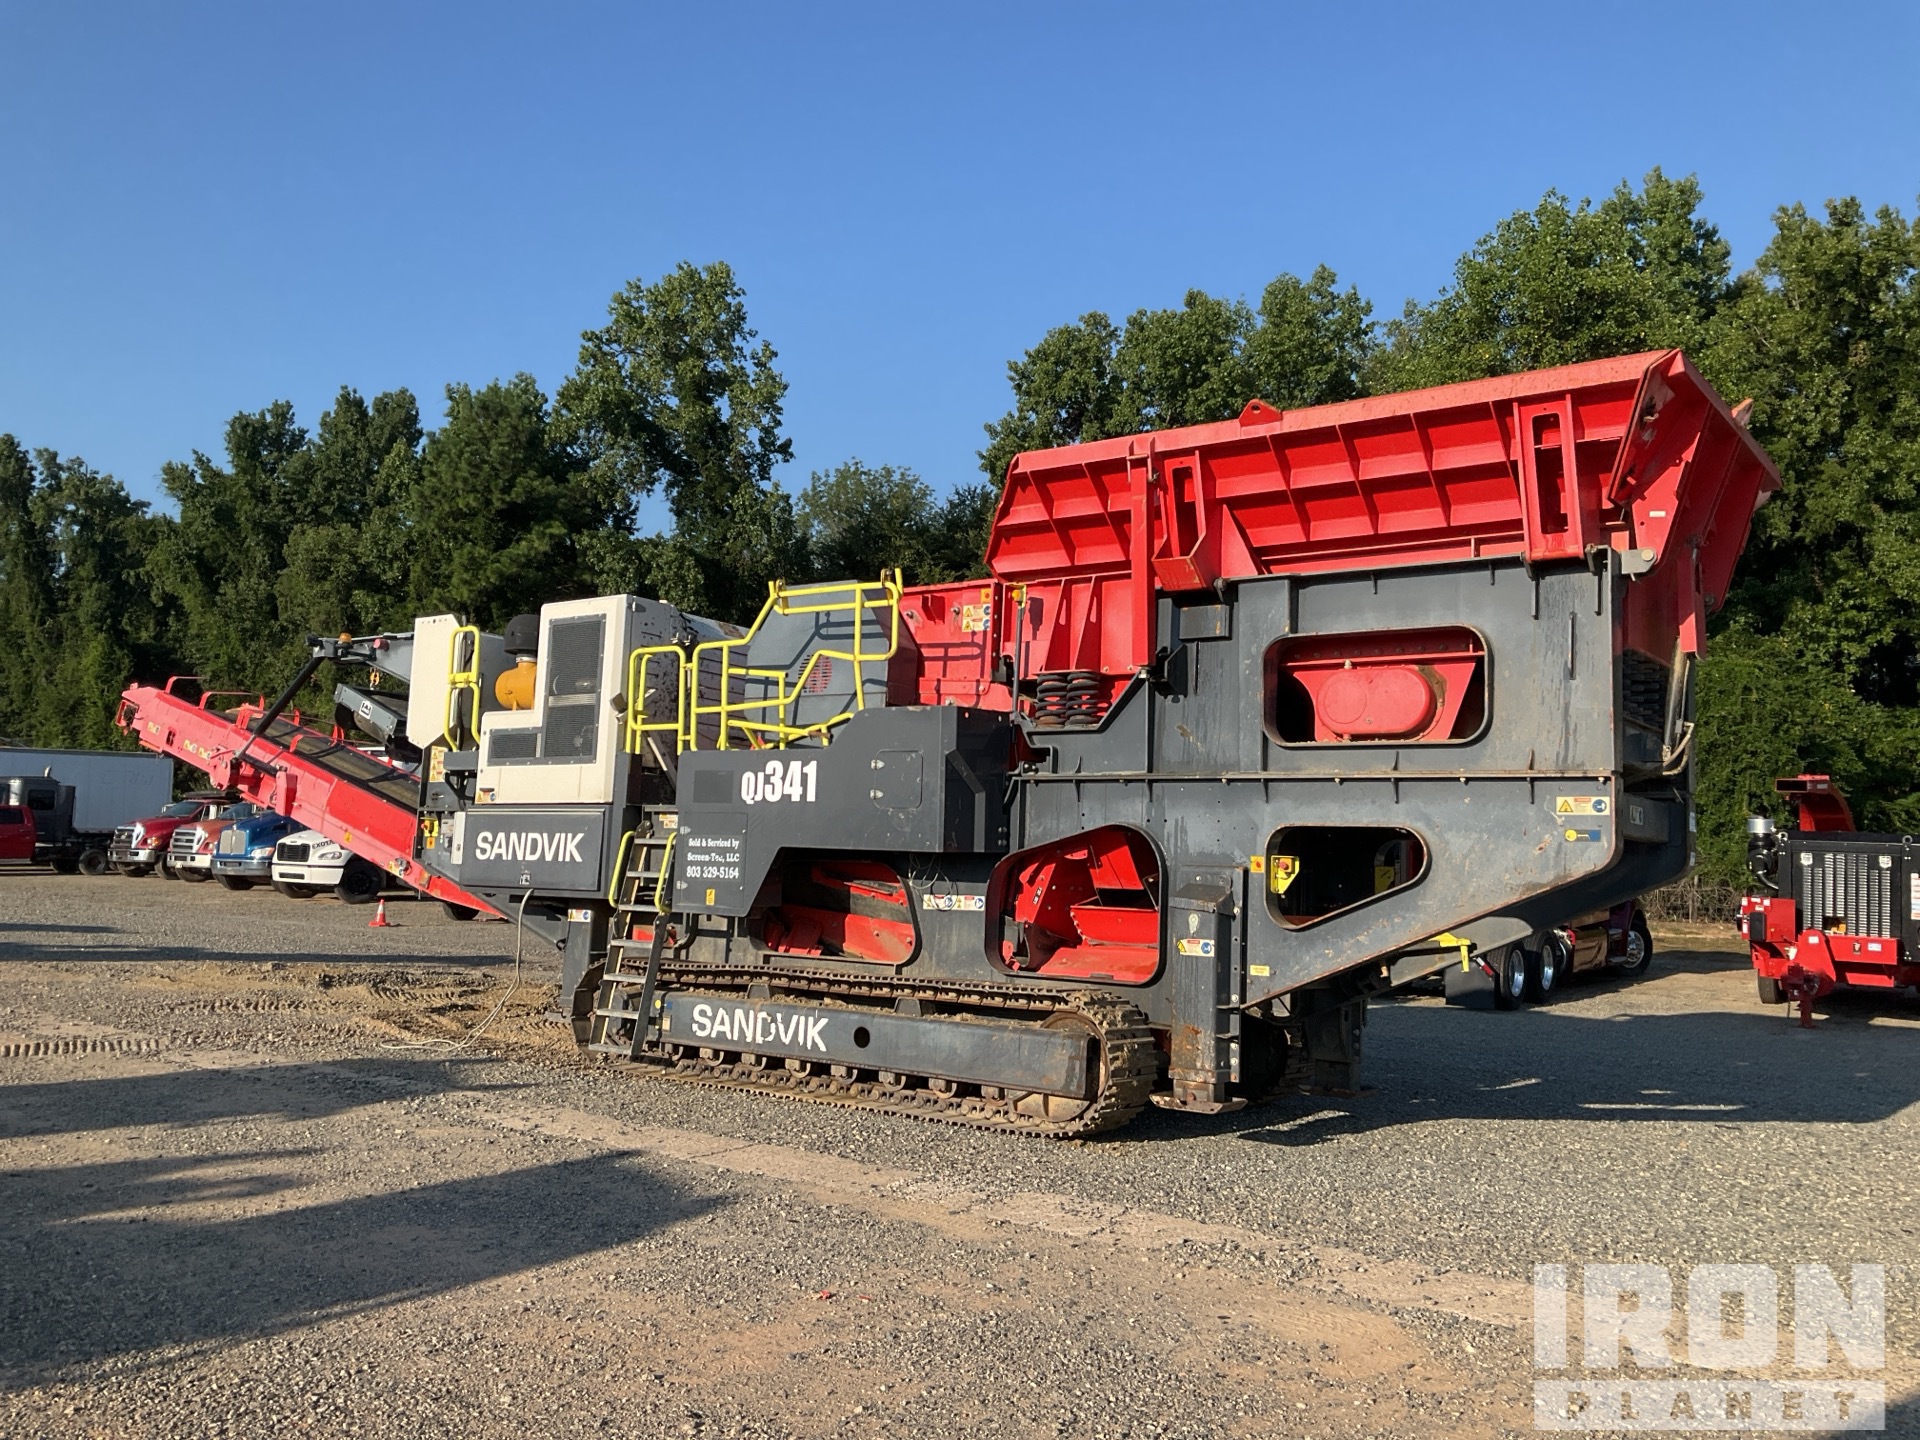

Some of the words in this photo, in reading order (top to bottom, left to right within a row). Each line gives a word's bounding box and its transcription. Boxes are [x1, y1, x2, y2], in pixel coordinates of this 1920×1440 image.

[741, 760, 817, 804] QJ341
[475, 831, 585, 862] SANDVIK
[688, 838, 700, 847] Sold
[701, 839, 707, 847] &
[707, 838, 731, 848] Serviced
[732, 839, 739, 849] by
[726, 853, 740, 862] LLC
[686, 866, 701, 878] 803
[702, 866, 739, 879] 329-5164
[691, 1003, 829, 1052] SANDVIK
